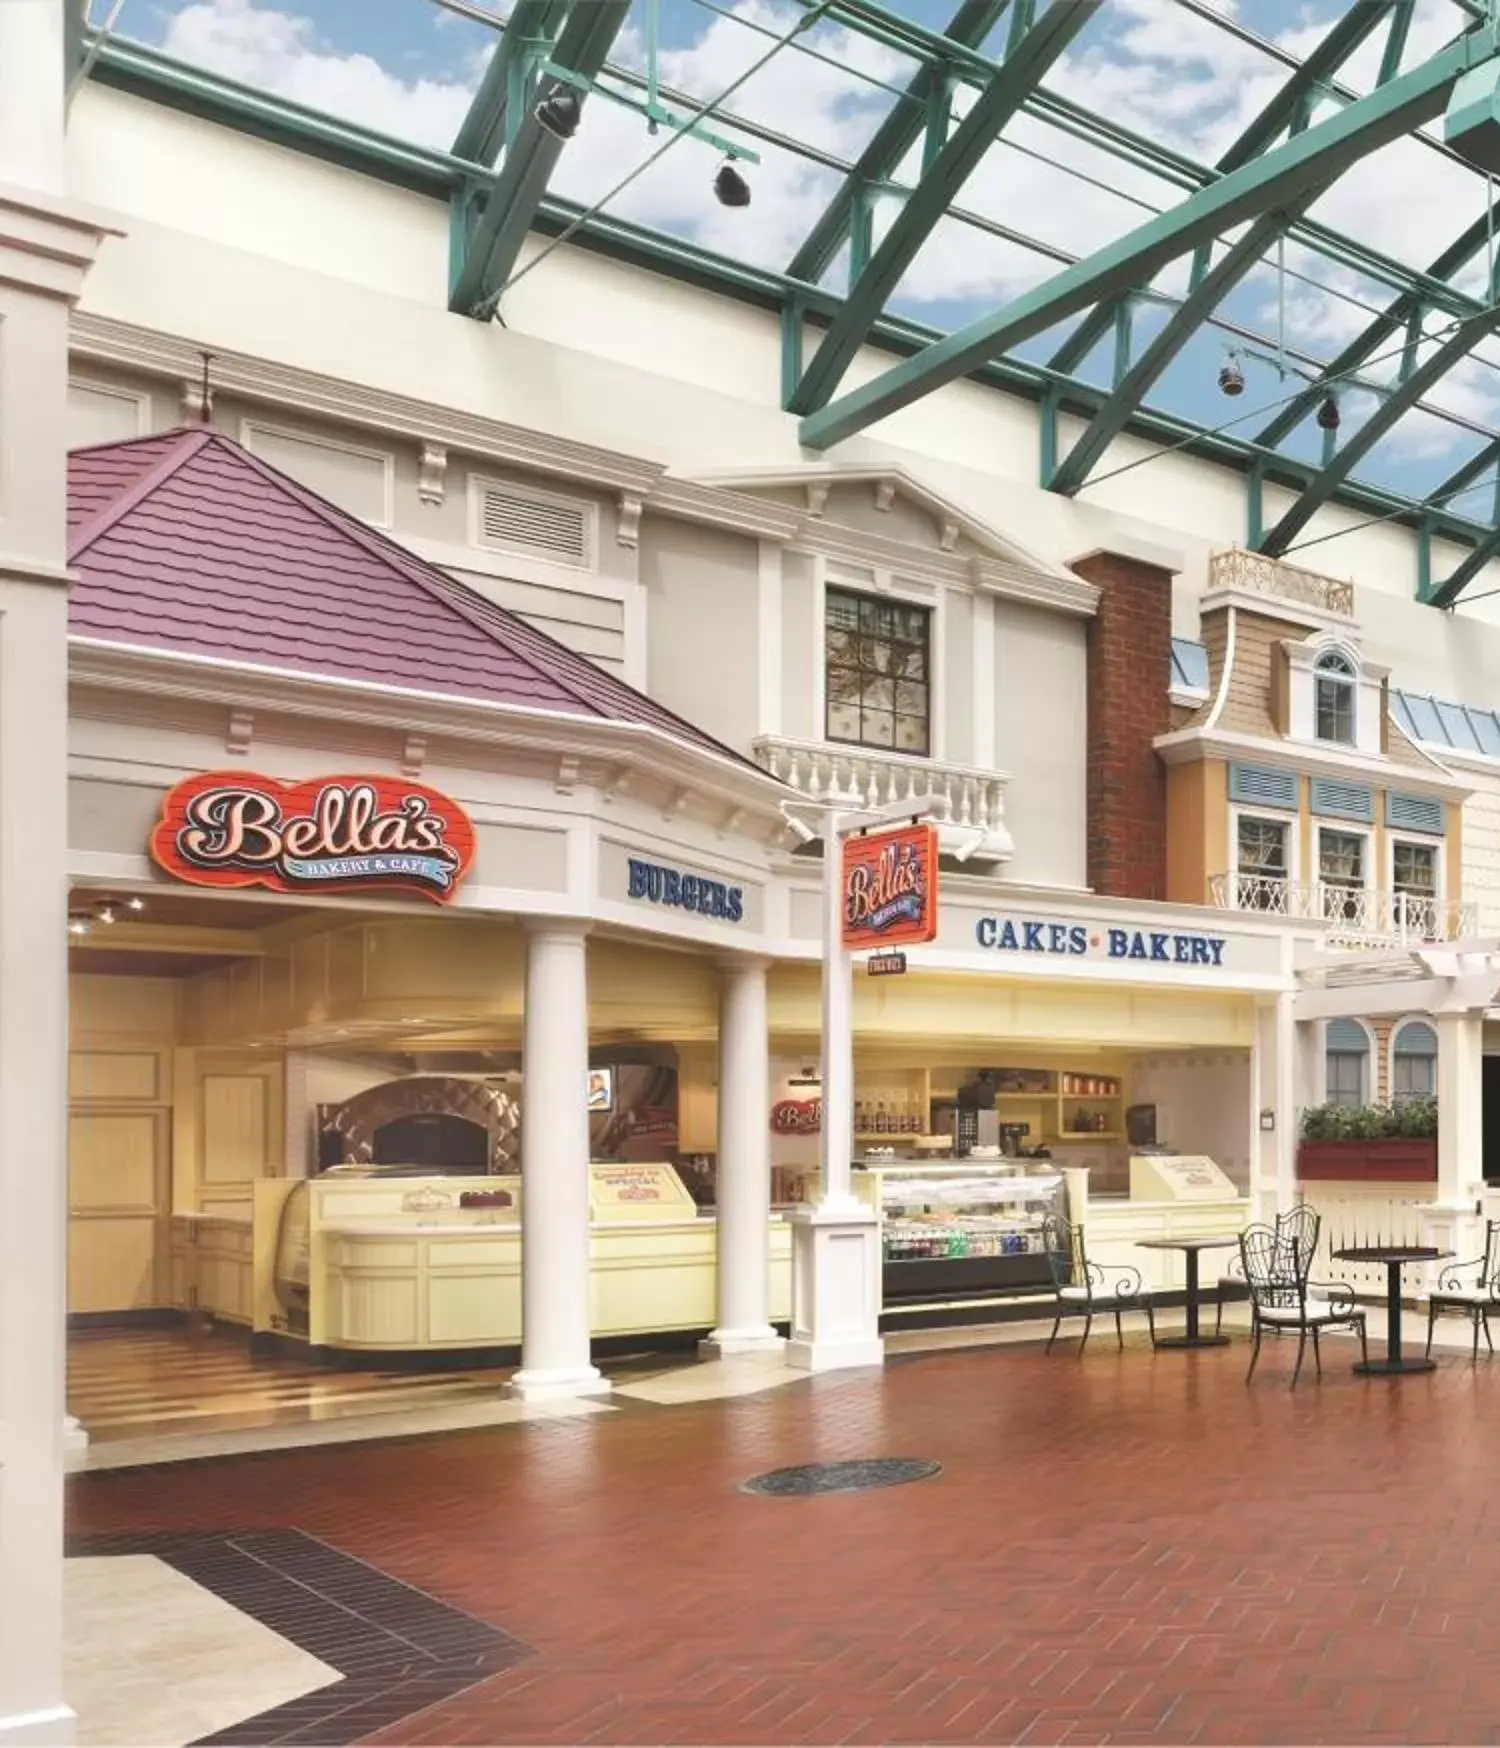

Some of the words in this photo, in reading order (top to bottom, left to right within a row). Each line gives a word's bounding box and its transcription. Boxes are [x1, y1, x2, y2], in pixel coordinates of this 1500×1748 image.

[180, 783, 447, 862] Bella's
[308, 859, 370, 876] BAKERY
[375, 858, 388, 870] &
[628, 858, 744, 922] BURGERS
[848, 842, 921, 921] Bella's
[976, 917, 1087, 954] CAKES
[1107, 927, 1226, 966] BAKERY
